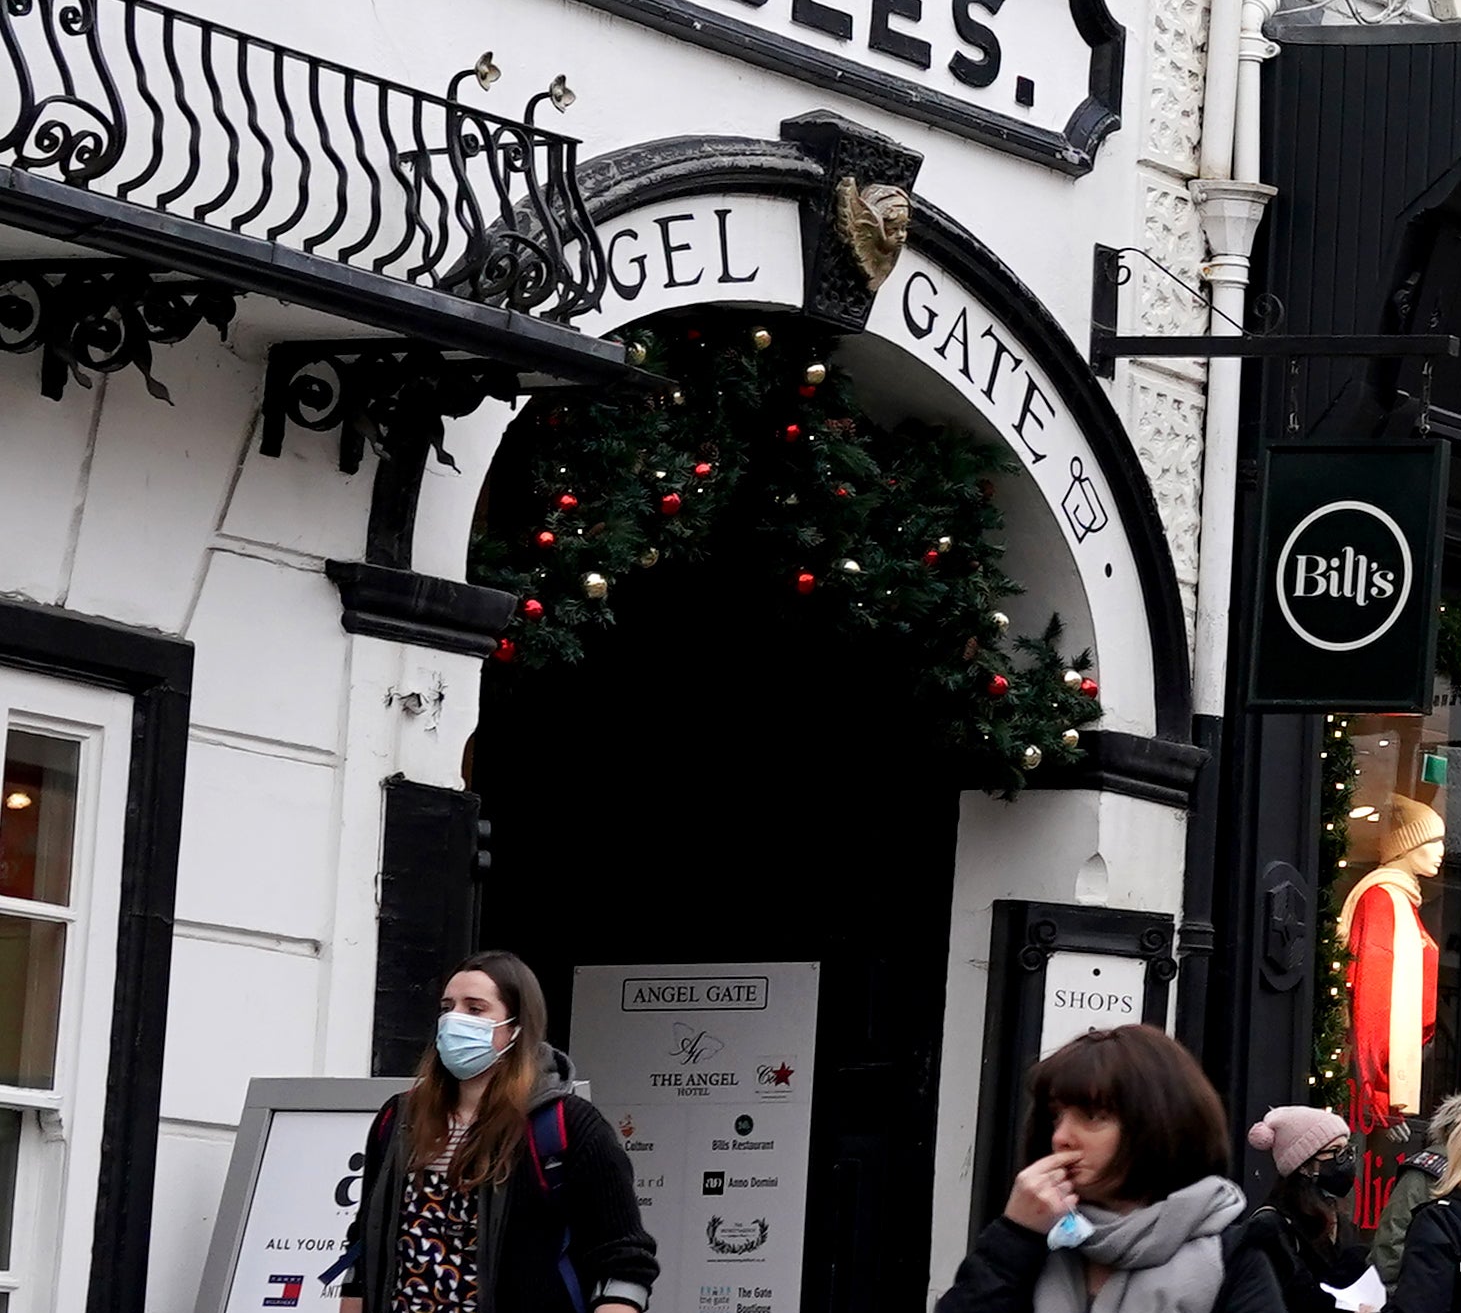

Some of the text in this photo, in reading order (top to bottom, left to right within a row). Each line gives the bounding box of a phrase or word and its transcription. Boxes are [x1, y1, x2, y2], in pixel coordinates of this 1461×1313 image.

[605, 208, 1055, 466] GEL GATE
[1293, 546, 1394, 607] Bill's
[632, 985, 758, 1003] ANGEL GATE
[1054, 989, 1133, 1014] SHOPS
[650, 1072, 740, 1087] THE ANGEL
[676, 1088, 711, 1097] HOTEL
[624, 1140, 654, 1152] Culture
[711, 1140, 774, 1151] Bills Restaurant
[728, 1176, 778, 1188] Anno Domini
[265, 1239, 291, 1250] ALL
[297, 1239, 335, 1251] YOUR
[738, 1287, 772, 1299] The Gate
